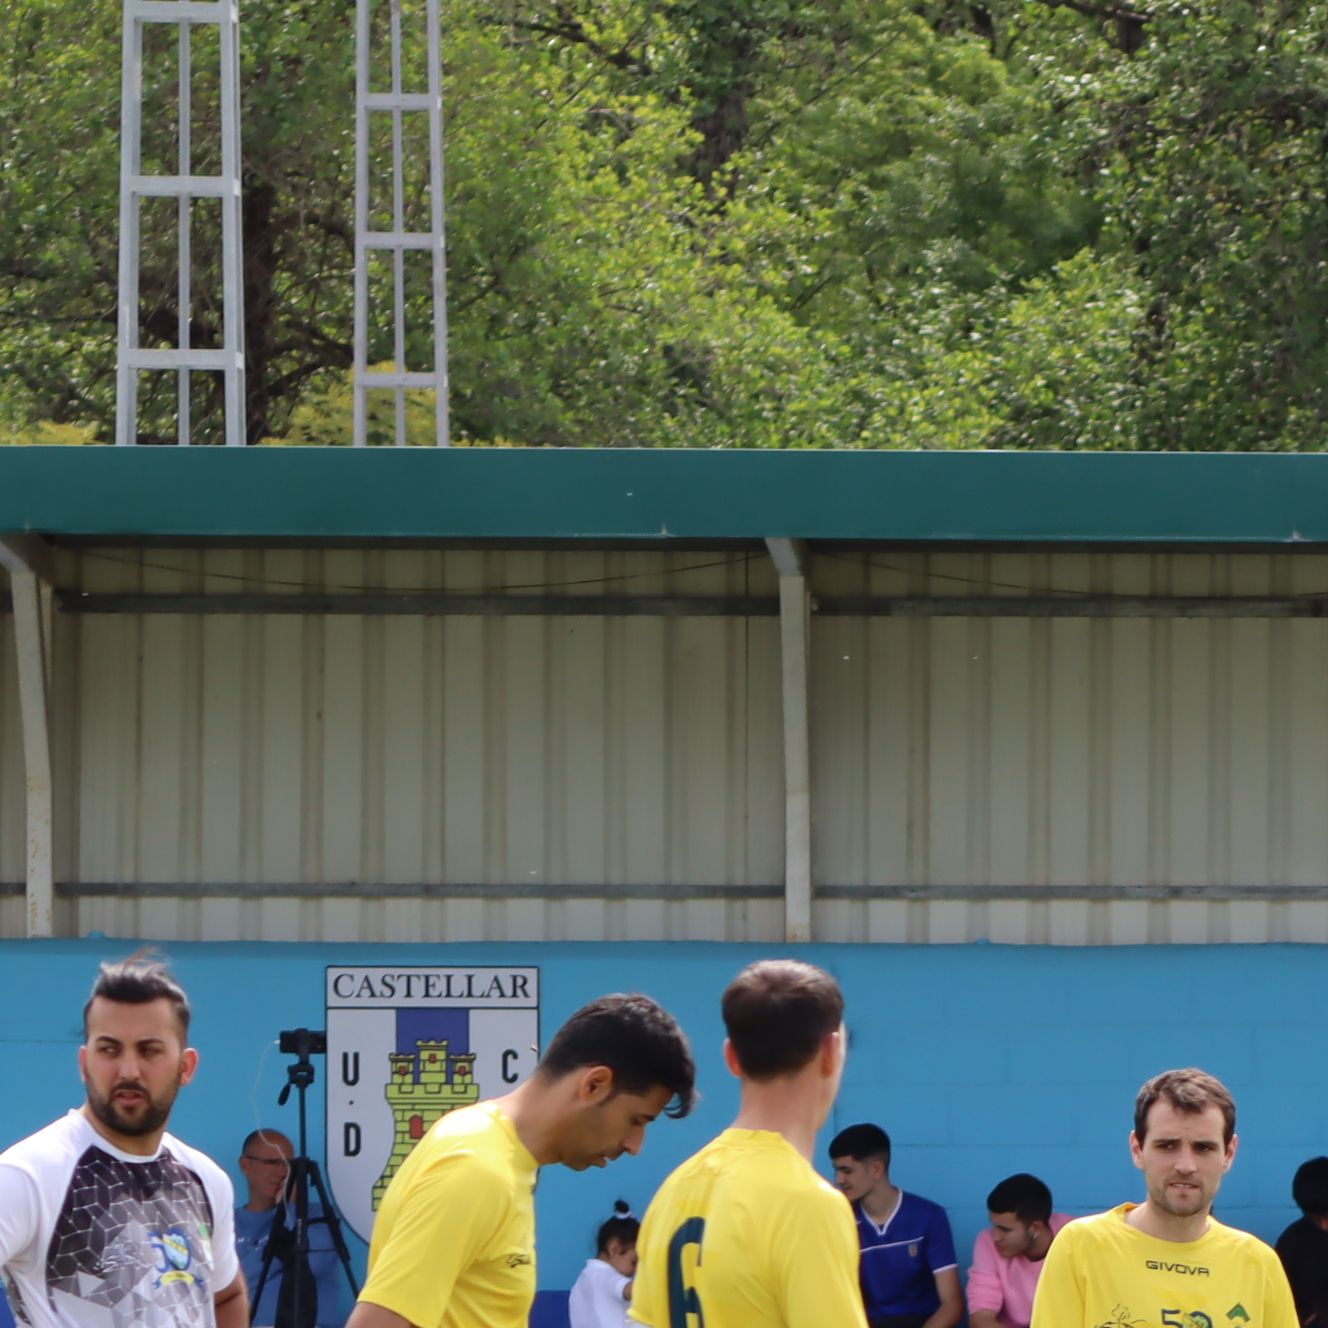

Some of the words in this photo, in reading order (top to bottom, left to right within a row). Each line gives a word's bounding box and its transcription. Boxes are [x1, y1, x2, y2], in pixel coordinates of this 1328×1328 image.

[333, 972, 531, 999] CASTELLAR
[341, 1051, 360, 1087] U
[501, 1049, 519, 1084] C
[343, 1122, 361, 1157] D
[1145, 1260, 1210, 1277] GIVOVA
